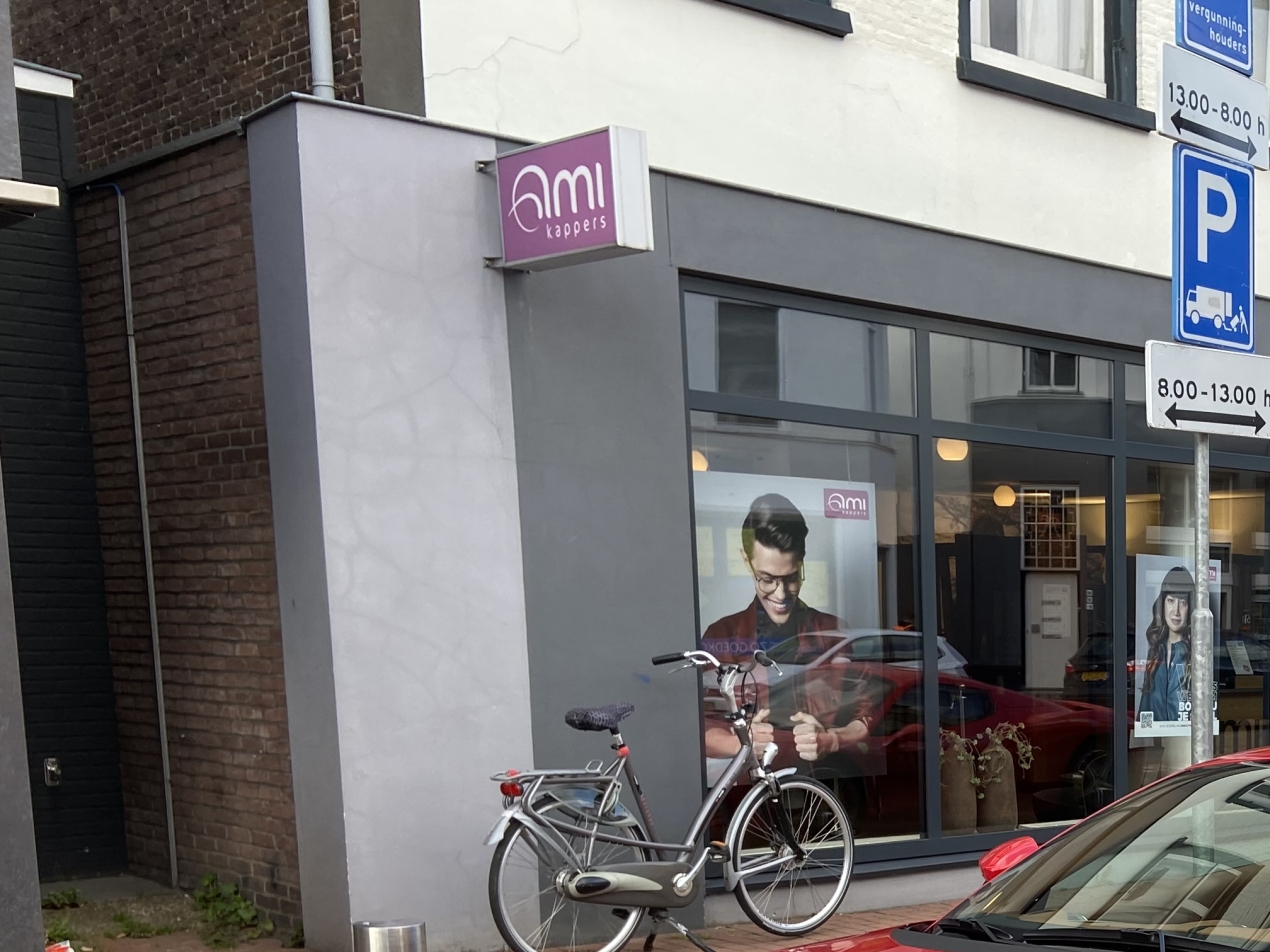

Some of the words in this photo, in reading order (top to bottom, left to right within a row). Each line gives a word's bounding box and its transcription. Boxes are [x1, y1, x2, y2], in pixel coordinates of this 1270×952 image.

[1189, 0, 1247, 37] vergunning-
[1210, 27, 1247, 55] houders
[1257, 116, 1265, 136] h
[546, 215, 607, 240] kappers
[1197, 169, 1238, 263] P
